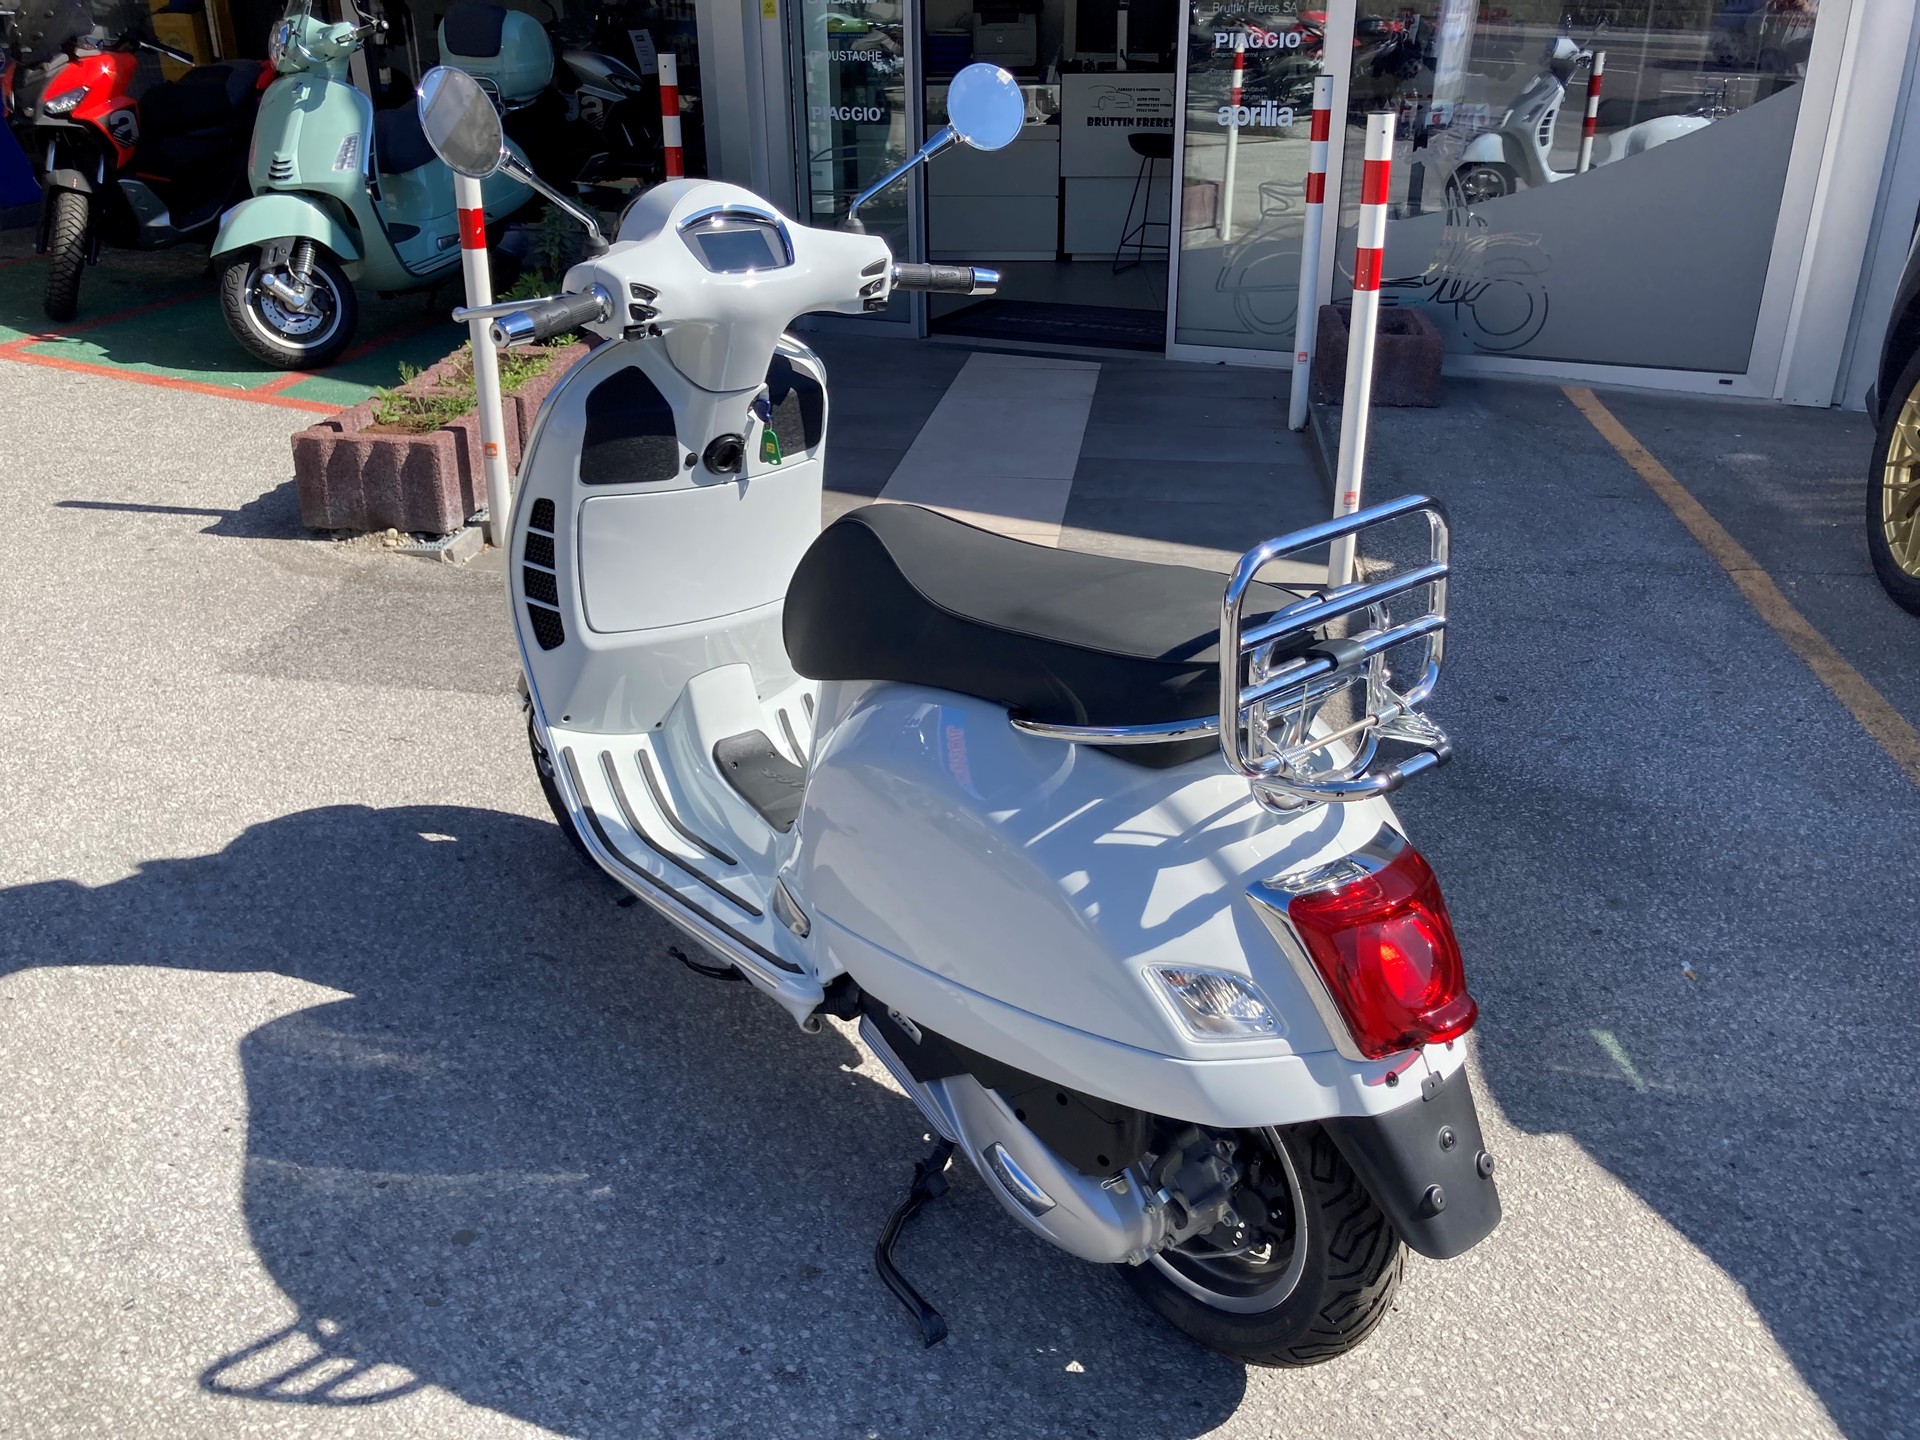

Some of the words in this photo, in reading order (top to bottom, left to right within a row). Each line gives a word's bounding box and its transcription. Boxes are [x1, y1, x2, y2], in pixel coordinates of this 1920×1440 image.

[1212, 2, 1245, 13] Bruttin
[1248, 2, 1280, 13] Frères
[1283, 2, 1298, 13] SA
[1214, 32, 1301, 49] PIAGGIO
[811, 106, 881, 122] PIAGGIO
[1086, 116, 1134, 127] BRUTTIN
[1217, 100, 1293, 127] aprilia
